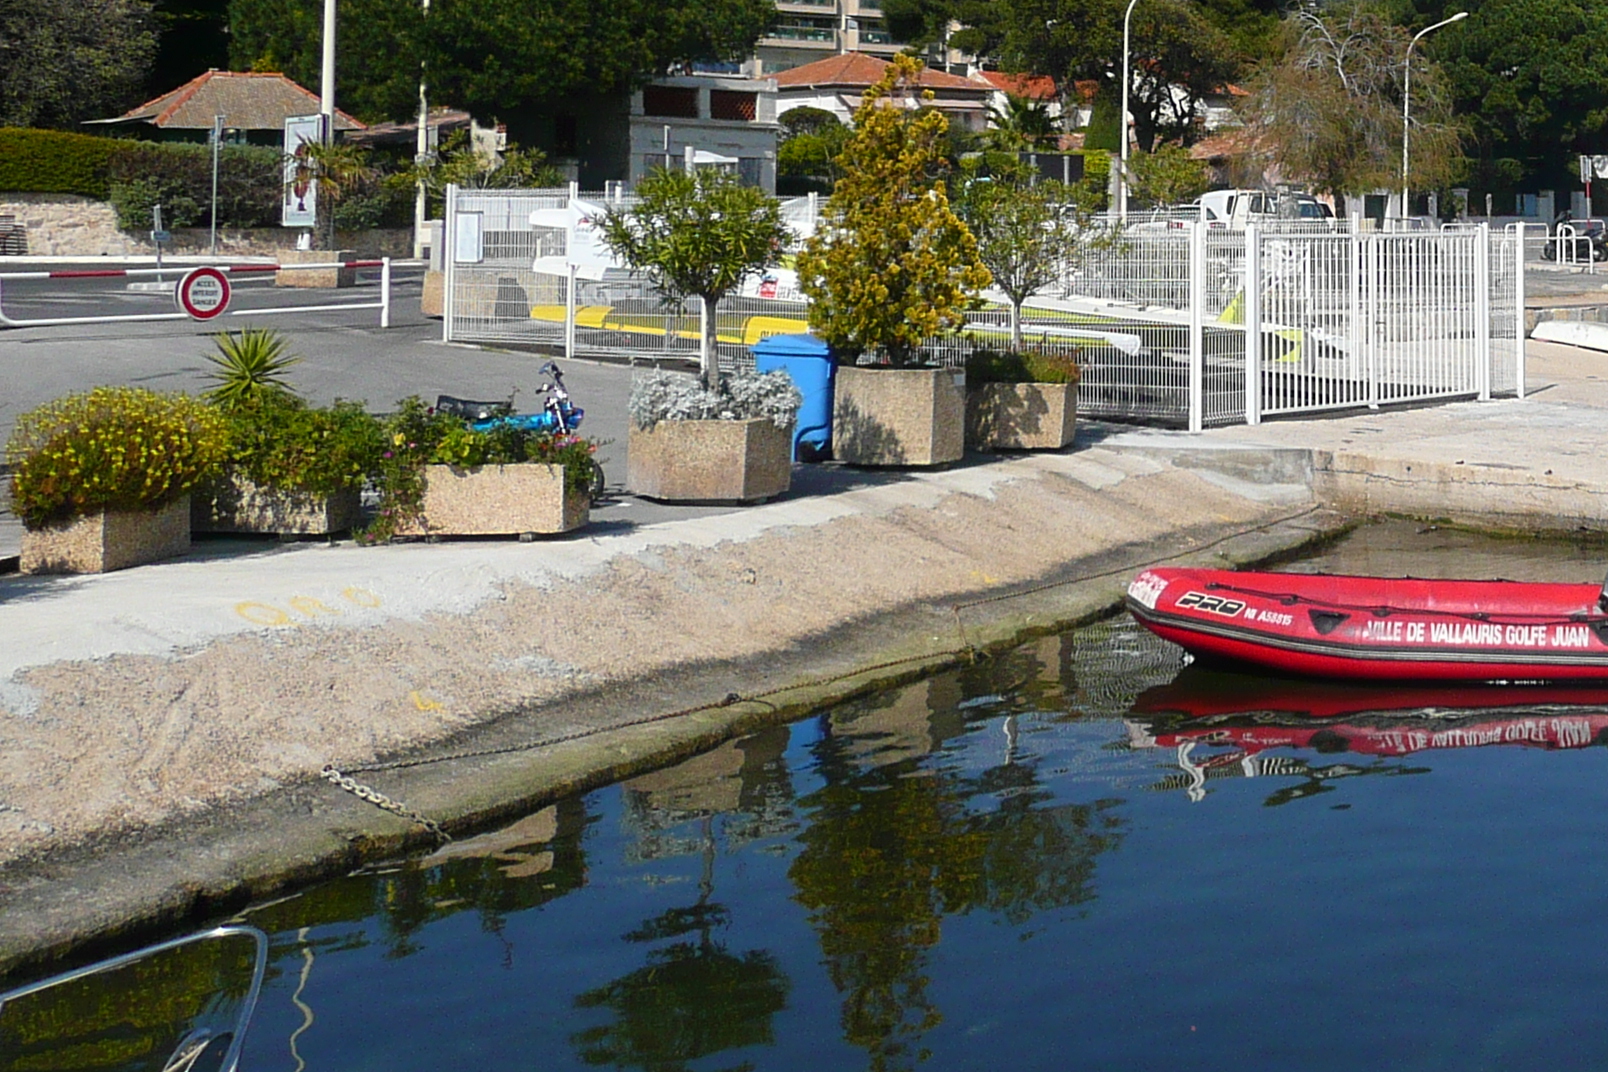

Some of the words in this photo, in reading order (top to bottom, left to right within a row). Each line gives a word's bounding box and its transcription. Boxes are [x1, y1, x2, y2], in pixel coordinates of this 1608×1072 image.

[1177, 592, 1245, 615] PRO
[1366, 620, 1403, 641] VILLE
[1406, 621, 1425, 642] DE
[1430, 622, 1503, 646] VALLAURIS
[1505, 624, 1548, 646] GOLFE
[1551, 625, 1589, 647] JUAN
